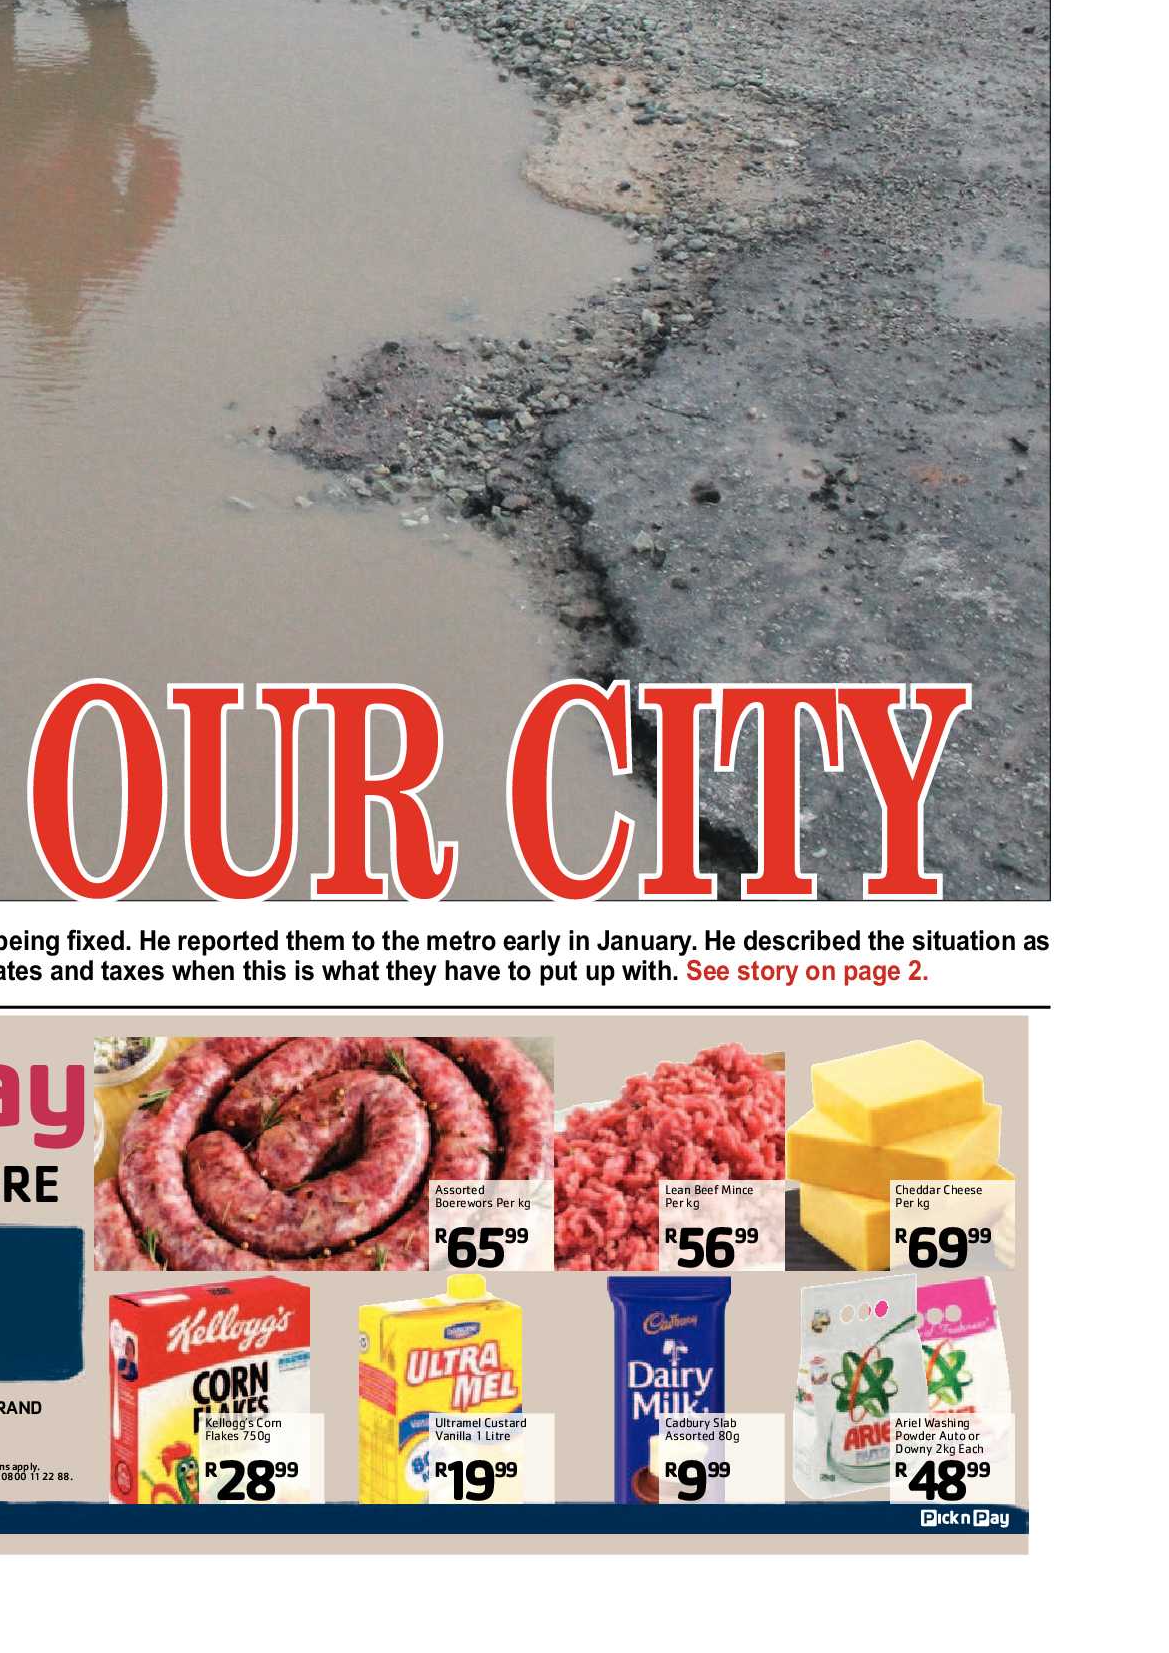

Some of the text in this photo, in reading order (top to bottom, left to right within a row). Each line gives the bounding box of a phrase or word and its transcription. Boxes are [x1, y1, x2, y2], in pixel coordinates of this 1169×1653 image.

[25, 680, 459, 902] OUR
[505, 680, 973, 902] CITY
[687, 960, 927, 986] See story on page 2.
[666, 1185, 753, 1194] Lean Beef Mince
[896, 1185, 982, 1194] Cheddar Cheese
[165, 1303, 295, 1354] Kellogg's
[642, 1311, 698, 1336] Cadbury
[406, 1339, 499, 1386] ULTRA
[627, 1360, 714, 1396] Dairy
[193, 1360, 268, 1405] CORN
[451, 1370, 518, 1412] MEL
